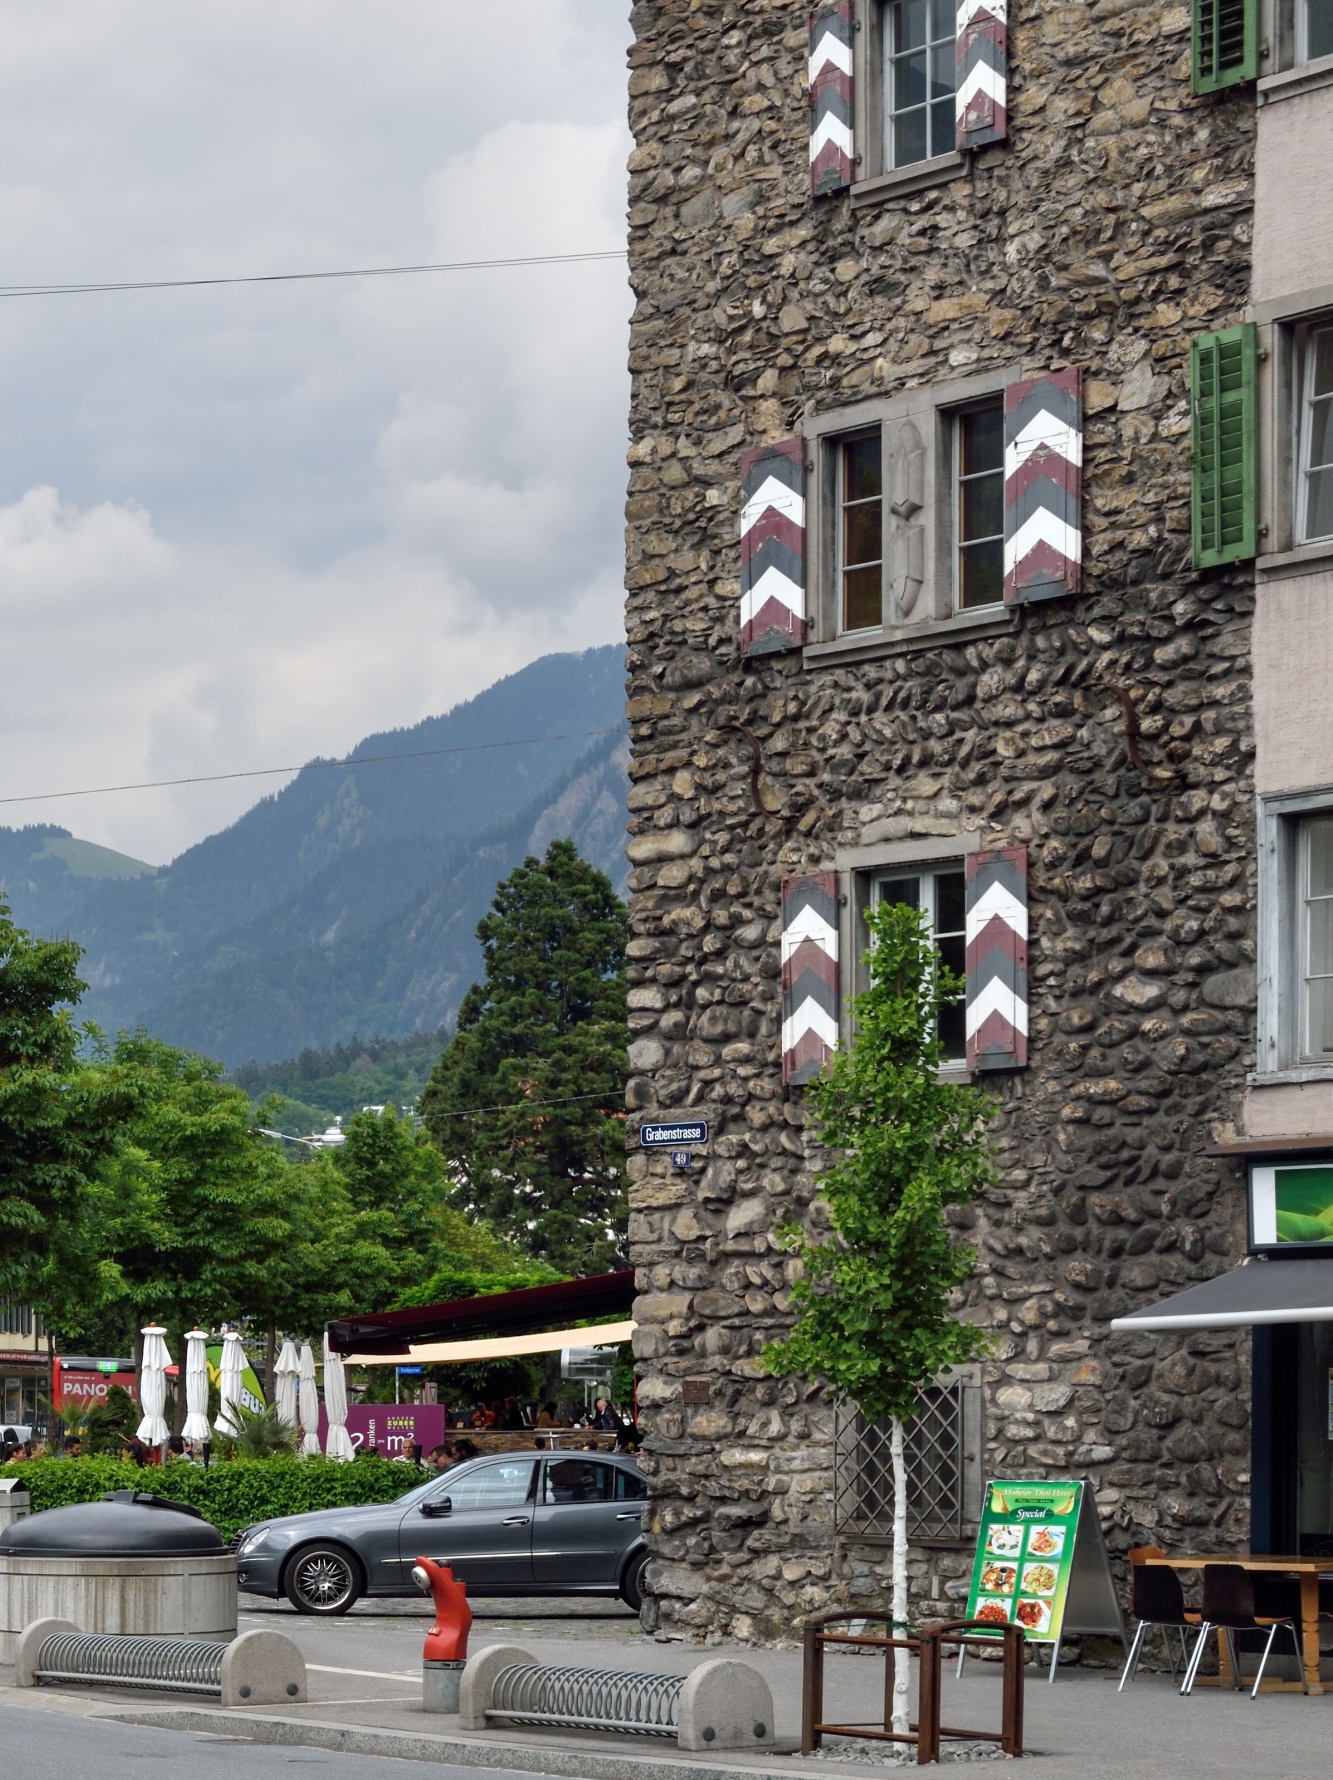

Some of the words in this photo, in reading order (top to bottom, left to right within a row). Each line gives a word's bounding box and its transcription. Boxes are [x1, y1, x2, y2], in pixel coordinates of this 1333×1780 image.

[646, 1127, 701, 1141] Grabenstrasse
[675, 1153, 686, 1165] 49
[367, 1419, 376, 1446] ranken
[1002, 1488, 1033, 1496] Malteser
[1034, 1488, 1051, 1496] Thai
[1016, 1508, 1047, 1522] Special
